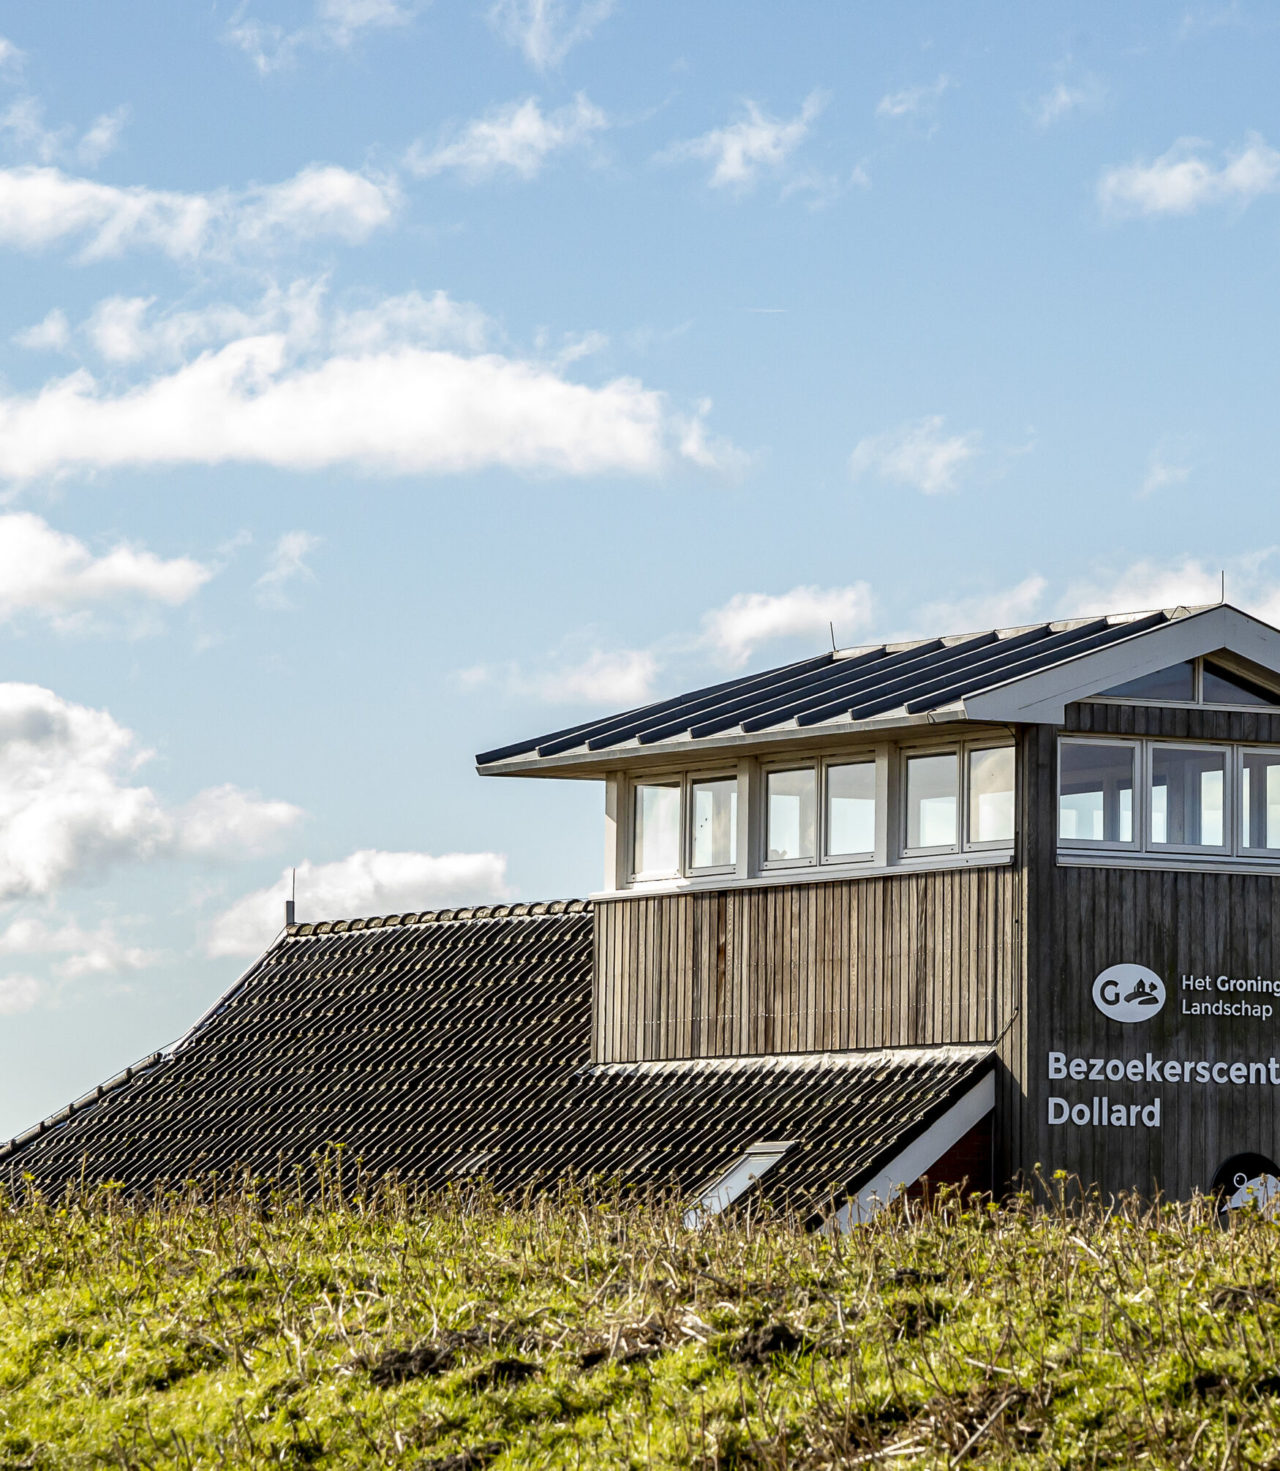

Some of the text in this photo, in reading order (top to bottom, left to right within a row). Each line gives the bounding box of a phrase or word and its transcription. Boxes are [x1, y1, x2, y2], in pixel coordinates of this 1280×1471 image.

[1099, 979, 1121, 1006] G
[1181, 974, 1212, 991] Het
[1181, 999, 1273, 1021] Landschap
[1047, 1096, 1161, 1127] Dollard
